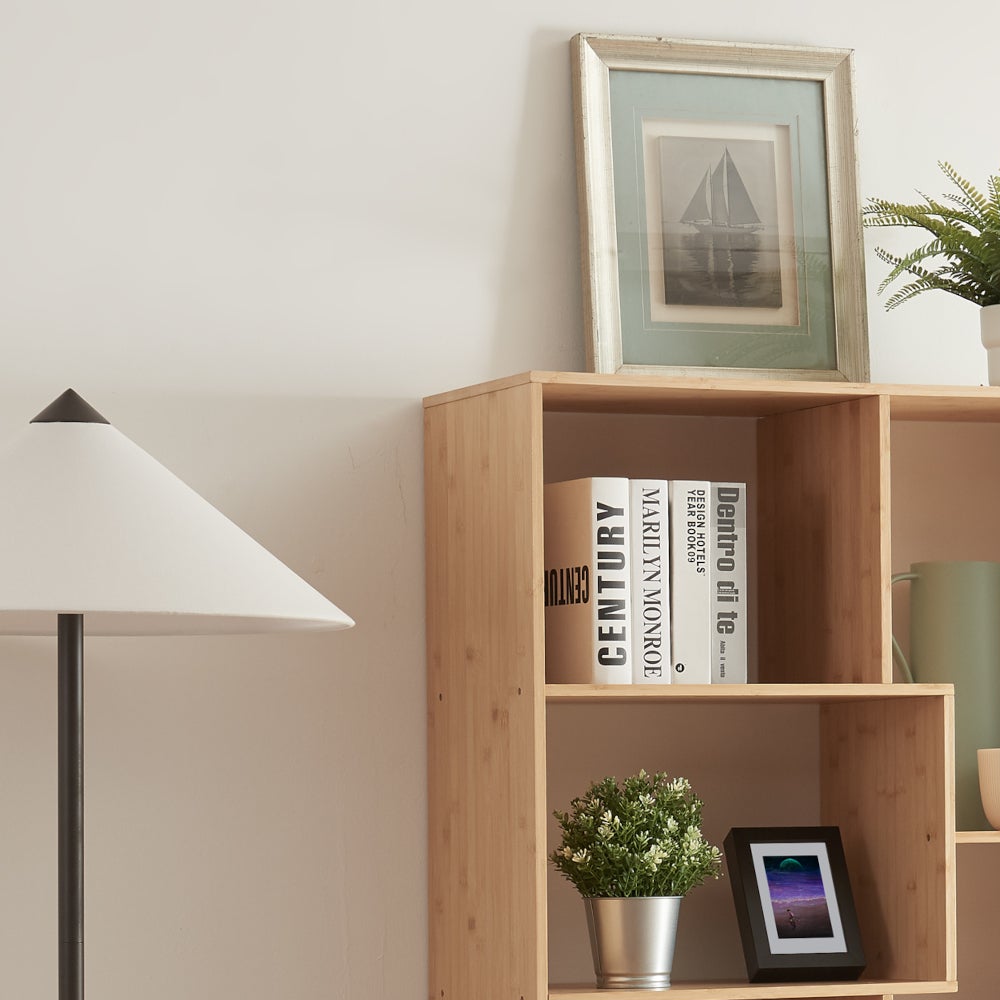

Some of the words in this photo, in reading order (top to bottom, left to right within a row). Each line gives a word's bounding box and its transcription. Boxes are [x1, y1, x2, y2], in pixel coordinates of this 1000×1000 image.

[687, 490, 696, 517] YEAR
[696, 490, 705, 528] DESIGN
[642, 488, 661, 583] MARILYN
[717, 487, 739, 572] Dentro
[696, 533, 705, 574] HOTELS
[596, 501, 627, 666] CENTURY
[717, 581, 739, 602] di
[643, 589, 662, 678] MONROE
[717, 611, 738, 634] te
